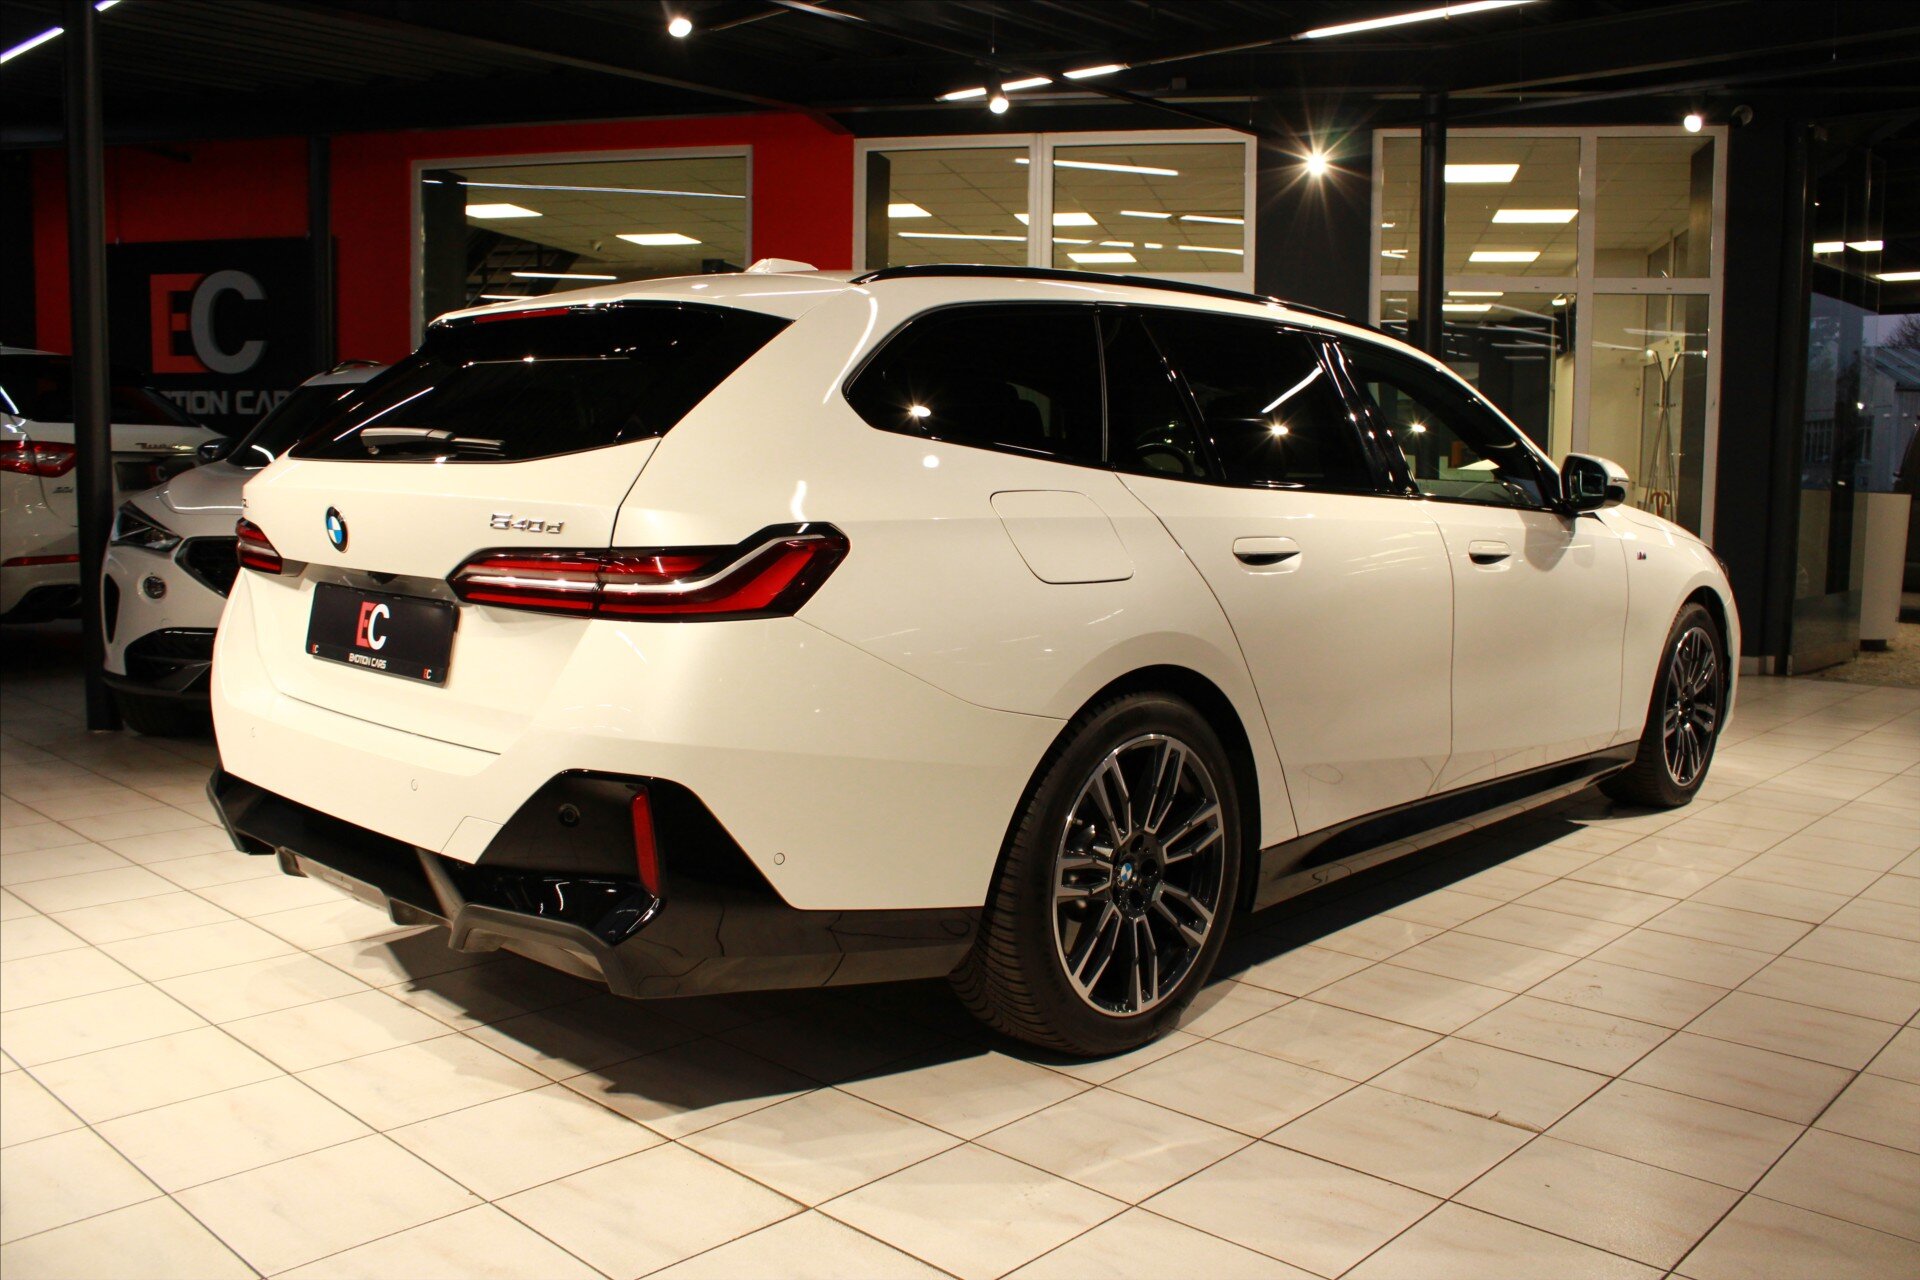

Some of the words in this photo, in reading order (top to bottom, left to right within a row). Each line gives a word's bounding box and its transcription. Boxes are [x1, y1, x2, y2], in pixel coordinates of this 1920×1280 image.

[150, 269, 267, 374] EC
[159, 390, 229, 414] TION
[490, 513, 564, 534] 540d
[355, 601, 390, 650] EC
[371, 657, 387, 669] CARS
